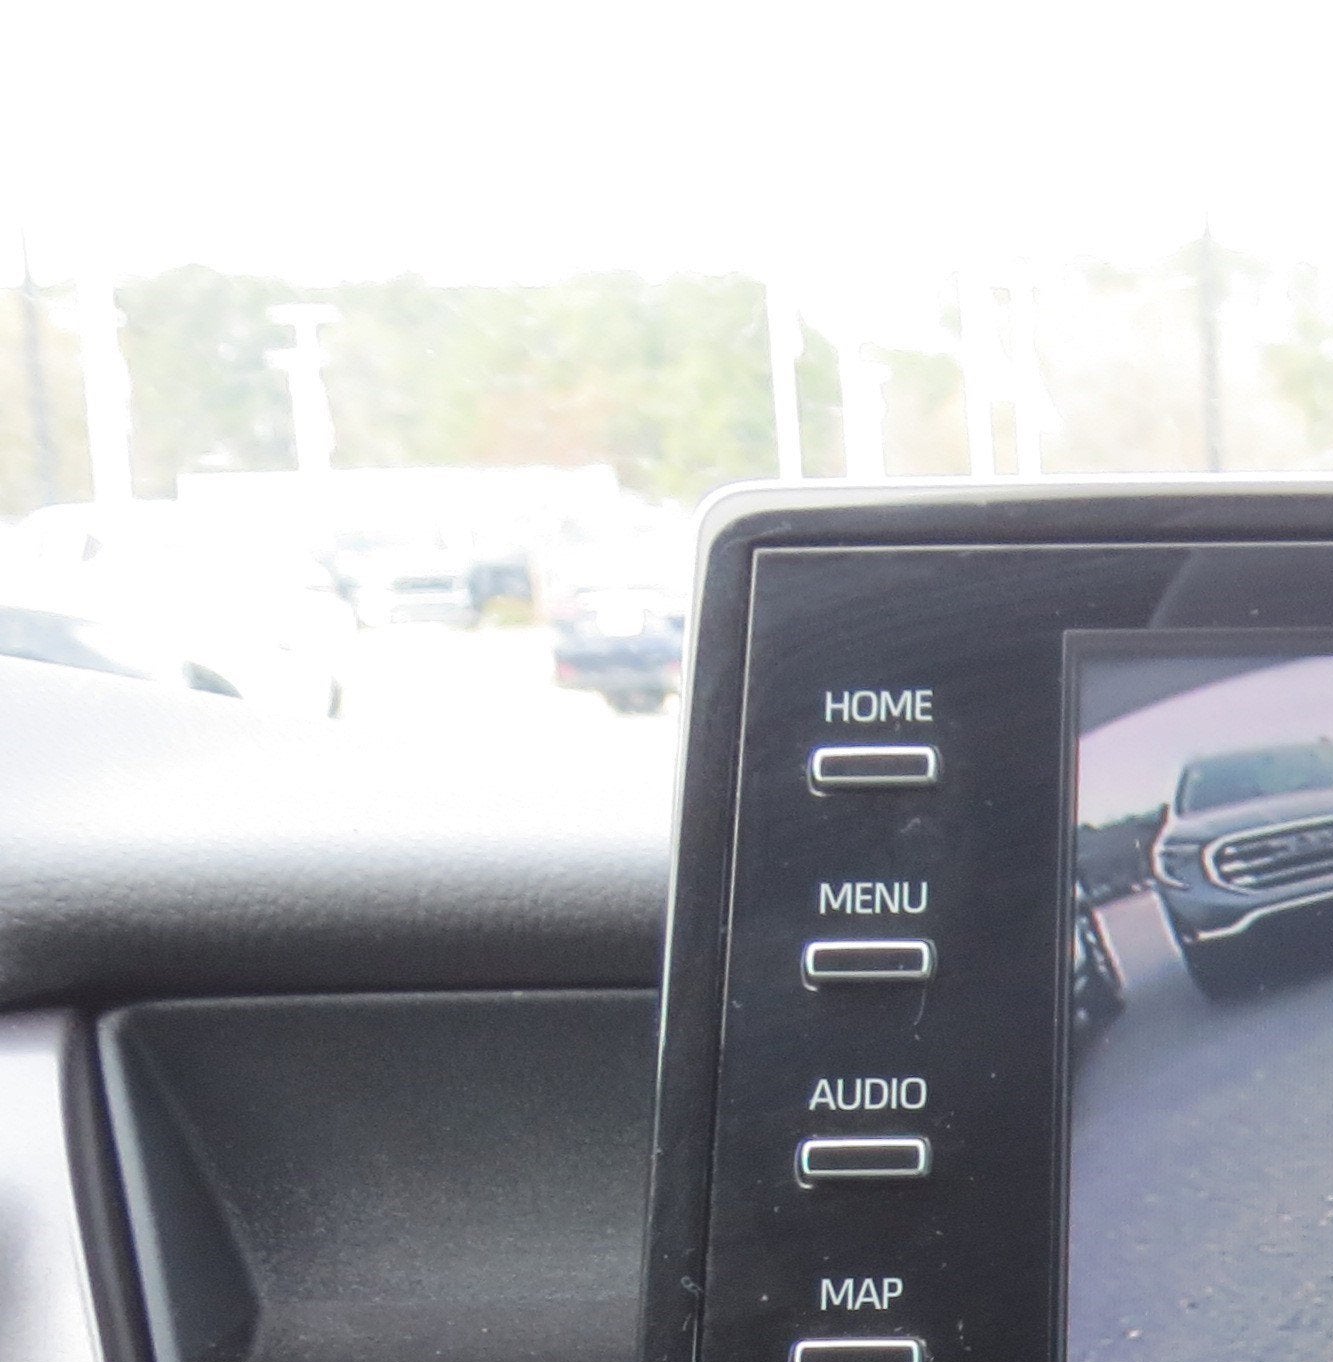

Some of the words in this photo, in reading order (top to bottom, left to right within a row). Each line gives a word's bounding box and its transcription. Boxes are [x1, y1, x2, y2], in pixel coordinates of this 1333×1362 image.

[825, 690, 933, 722] HOME
[819, 882, 928, 914] MENU
[809, 1077, 927, 1110] AUDIO
[820, 1278, 903, 1311] MAP
